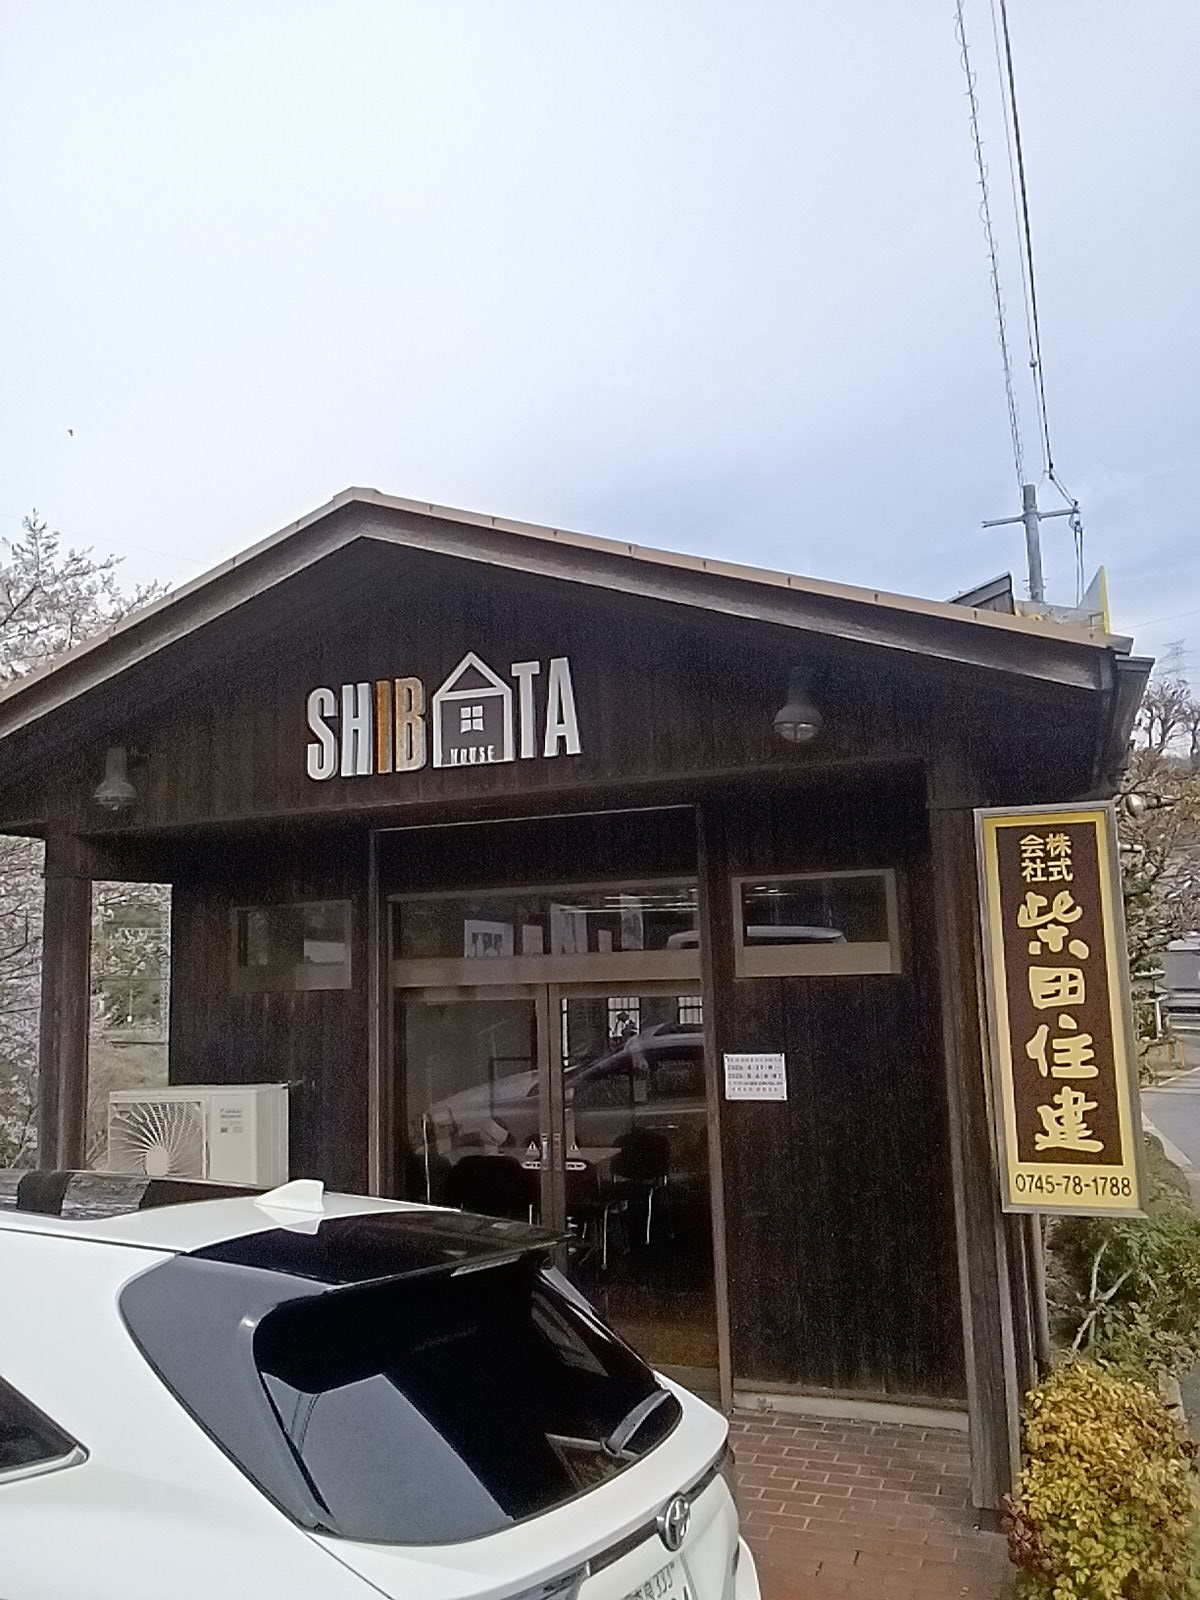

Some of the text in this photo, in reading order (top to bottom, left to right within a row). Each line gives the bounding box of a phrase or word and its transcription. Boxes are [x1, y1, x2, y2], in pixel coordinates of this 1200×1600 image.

[450, 745, 496, 764] HOUSE
[1017, 890, 1104, 1153] 柴田住建
[1015, 1173, 1132, 1198] 0745-78-1788
